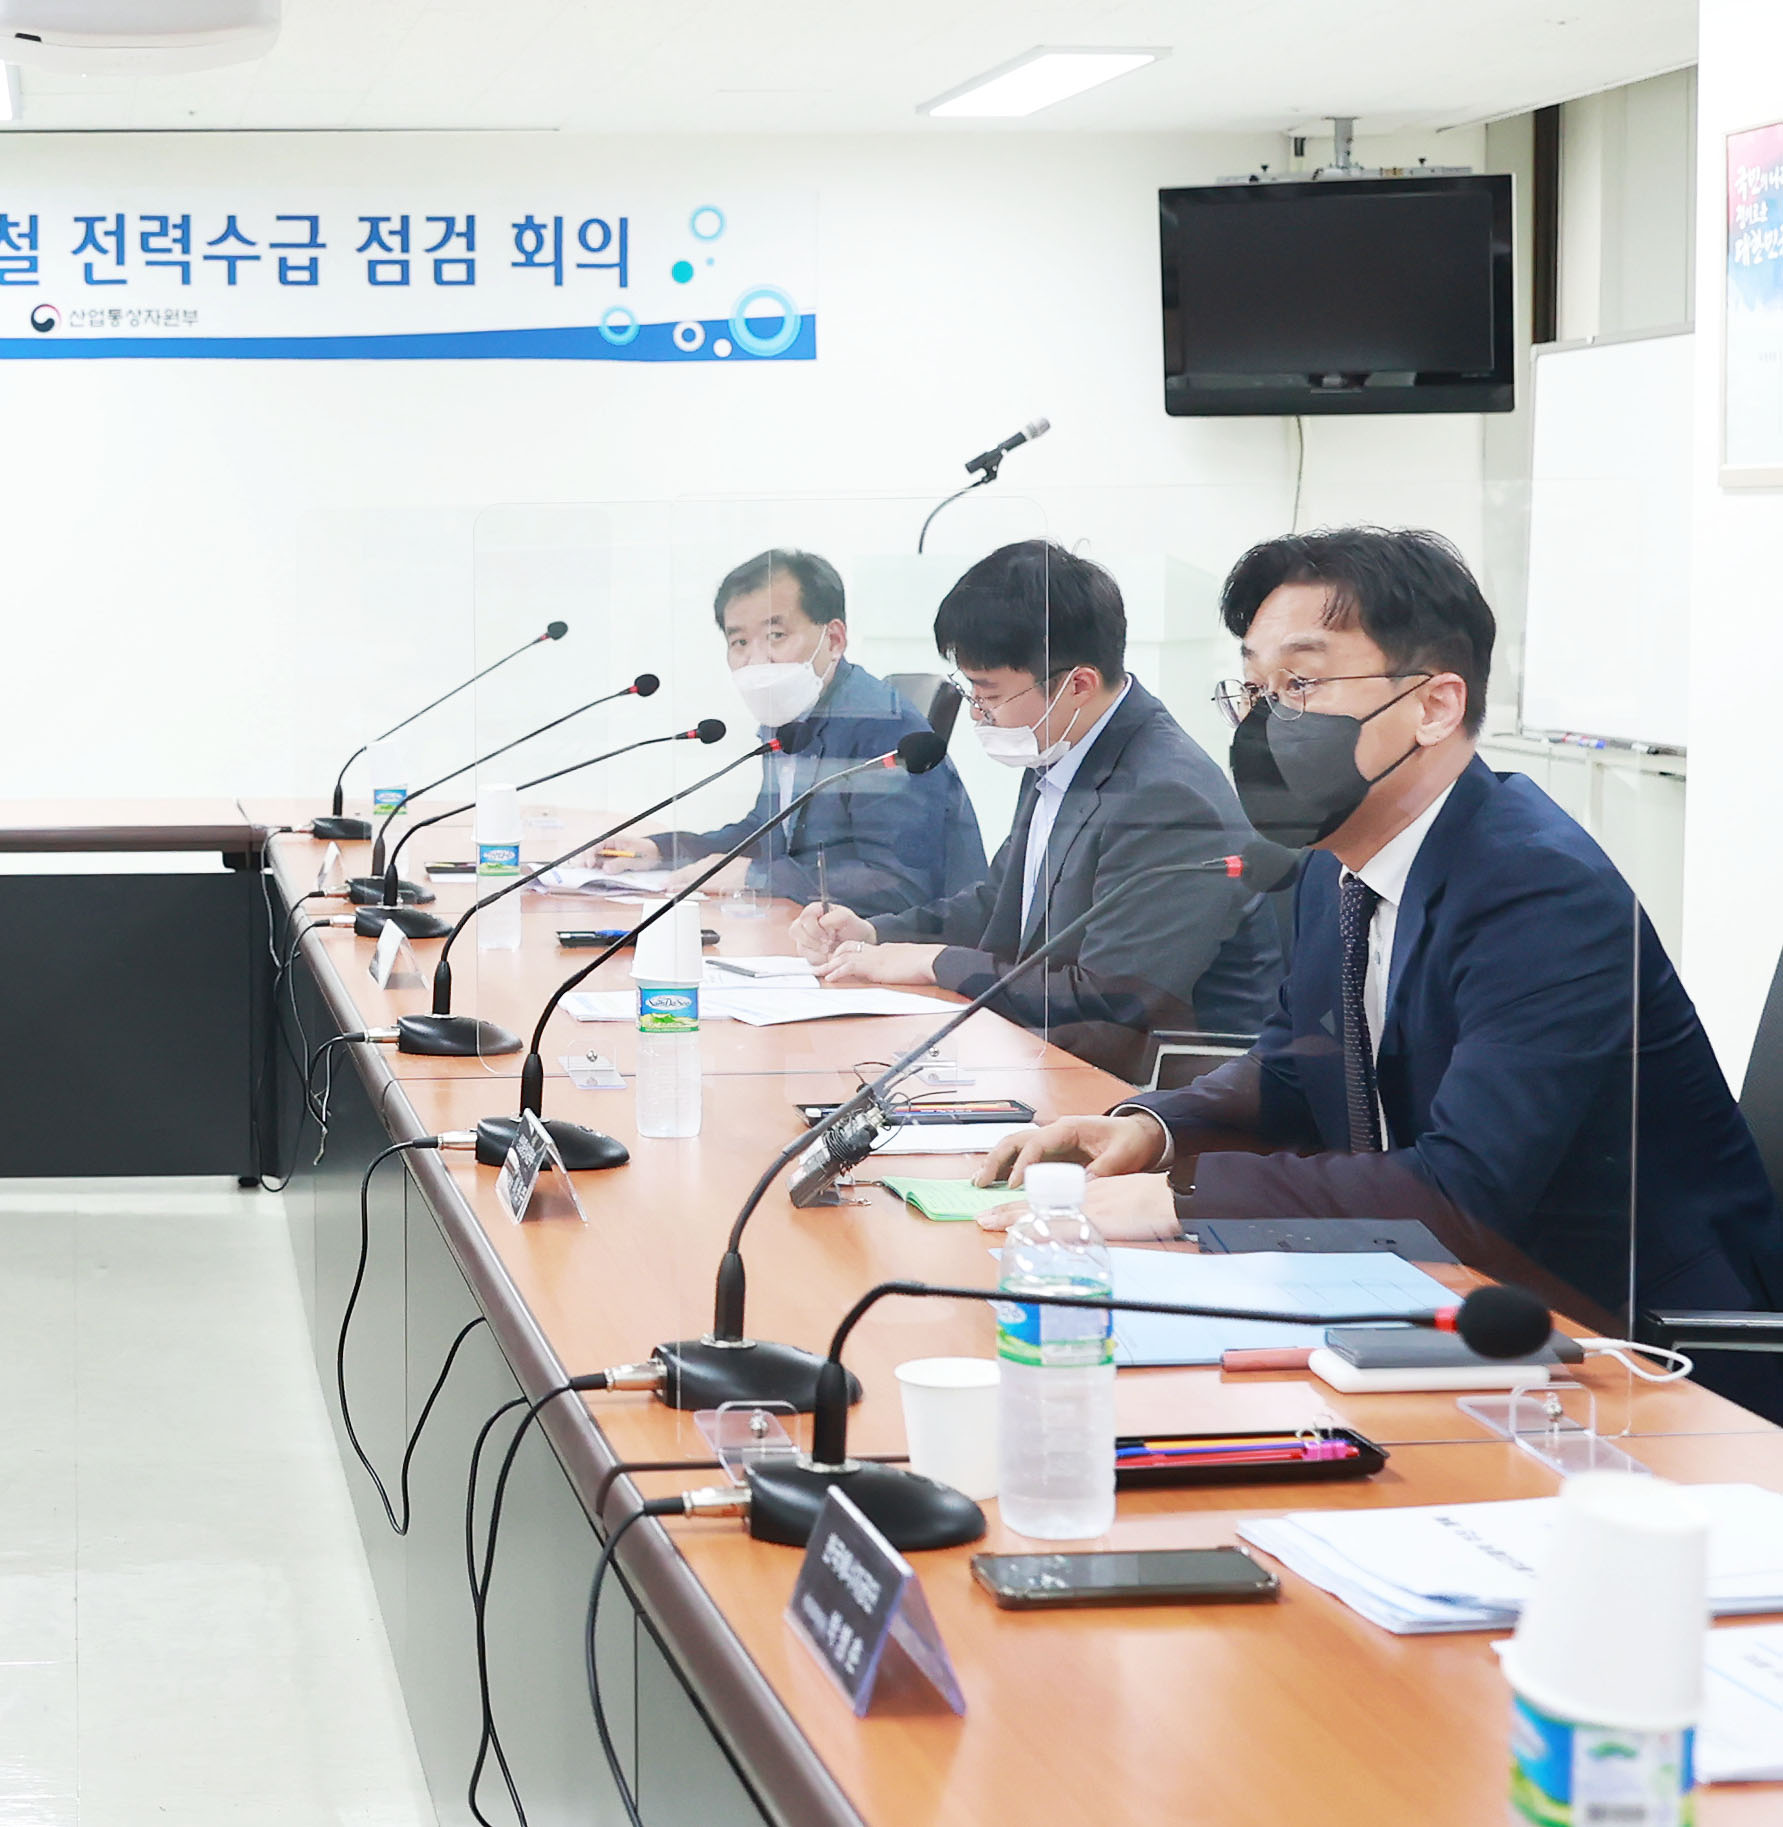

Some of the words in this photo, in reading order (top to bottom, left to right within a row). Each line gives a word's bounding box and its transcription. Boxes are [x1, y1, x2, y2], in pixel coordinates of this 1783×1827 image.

[70, 212, 327, 286] 전력수급
[355, 213, 476, 287] 점검
[510, 214, 630, 289] 회의
[69, 308, 200, 328] 산업통상자원부
